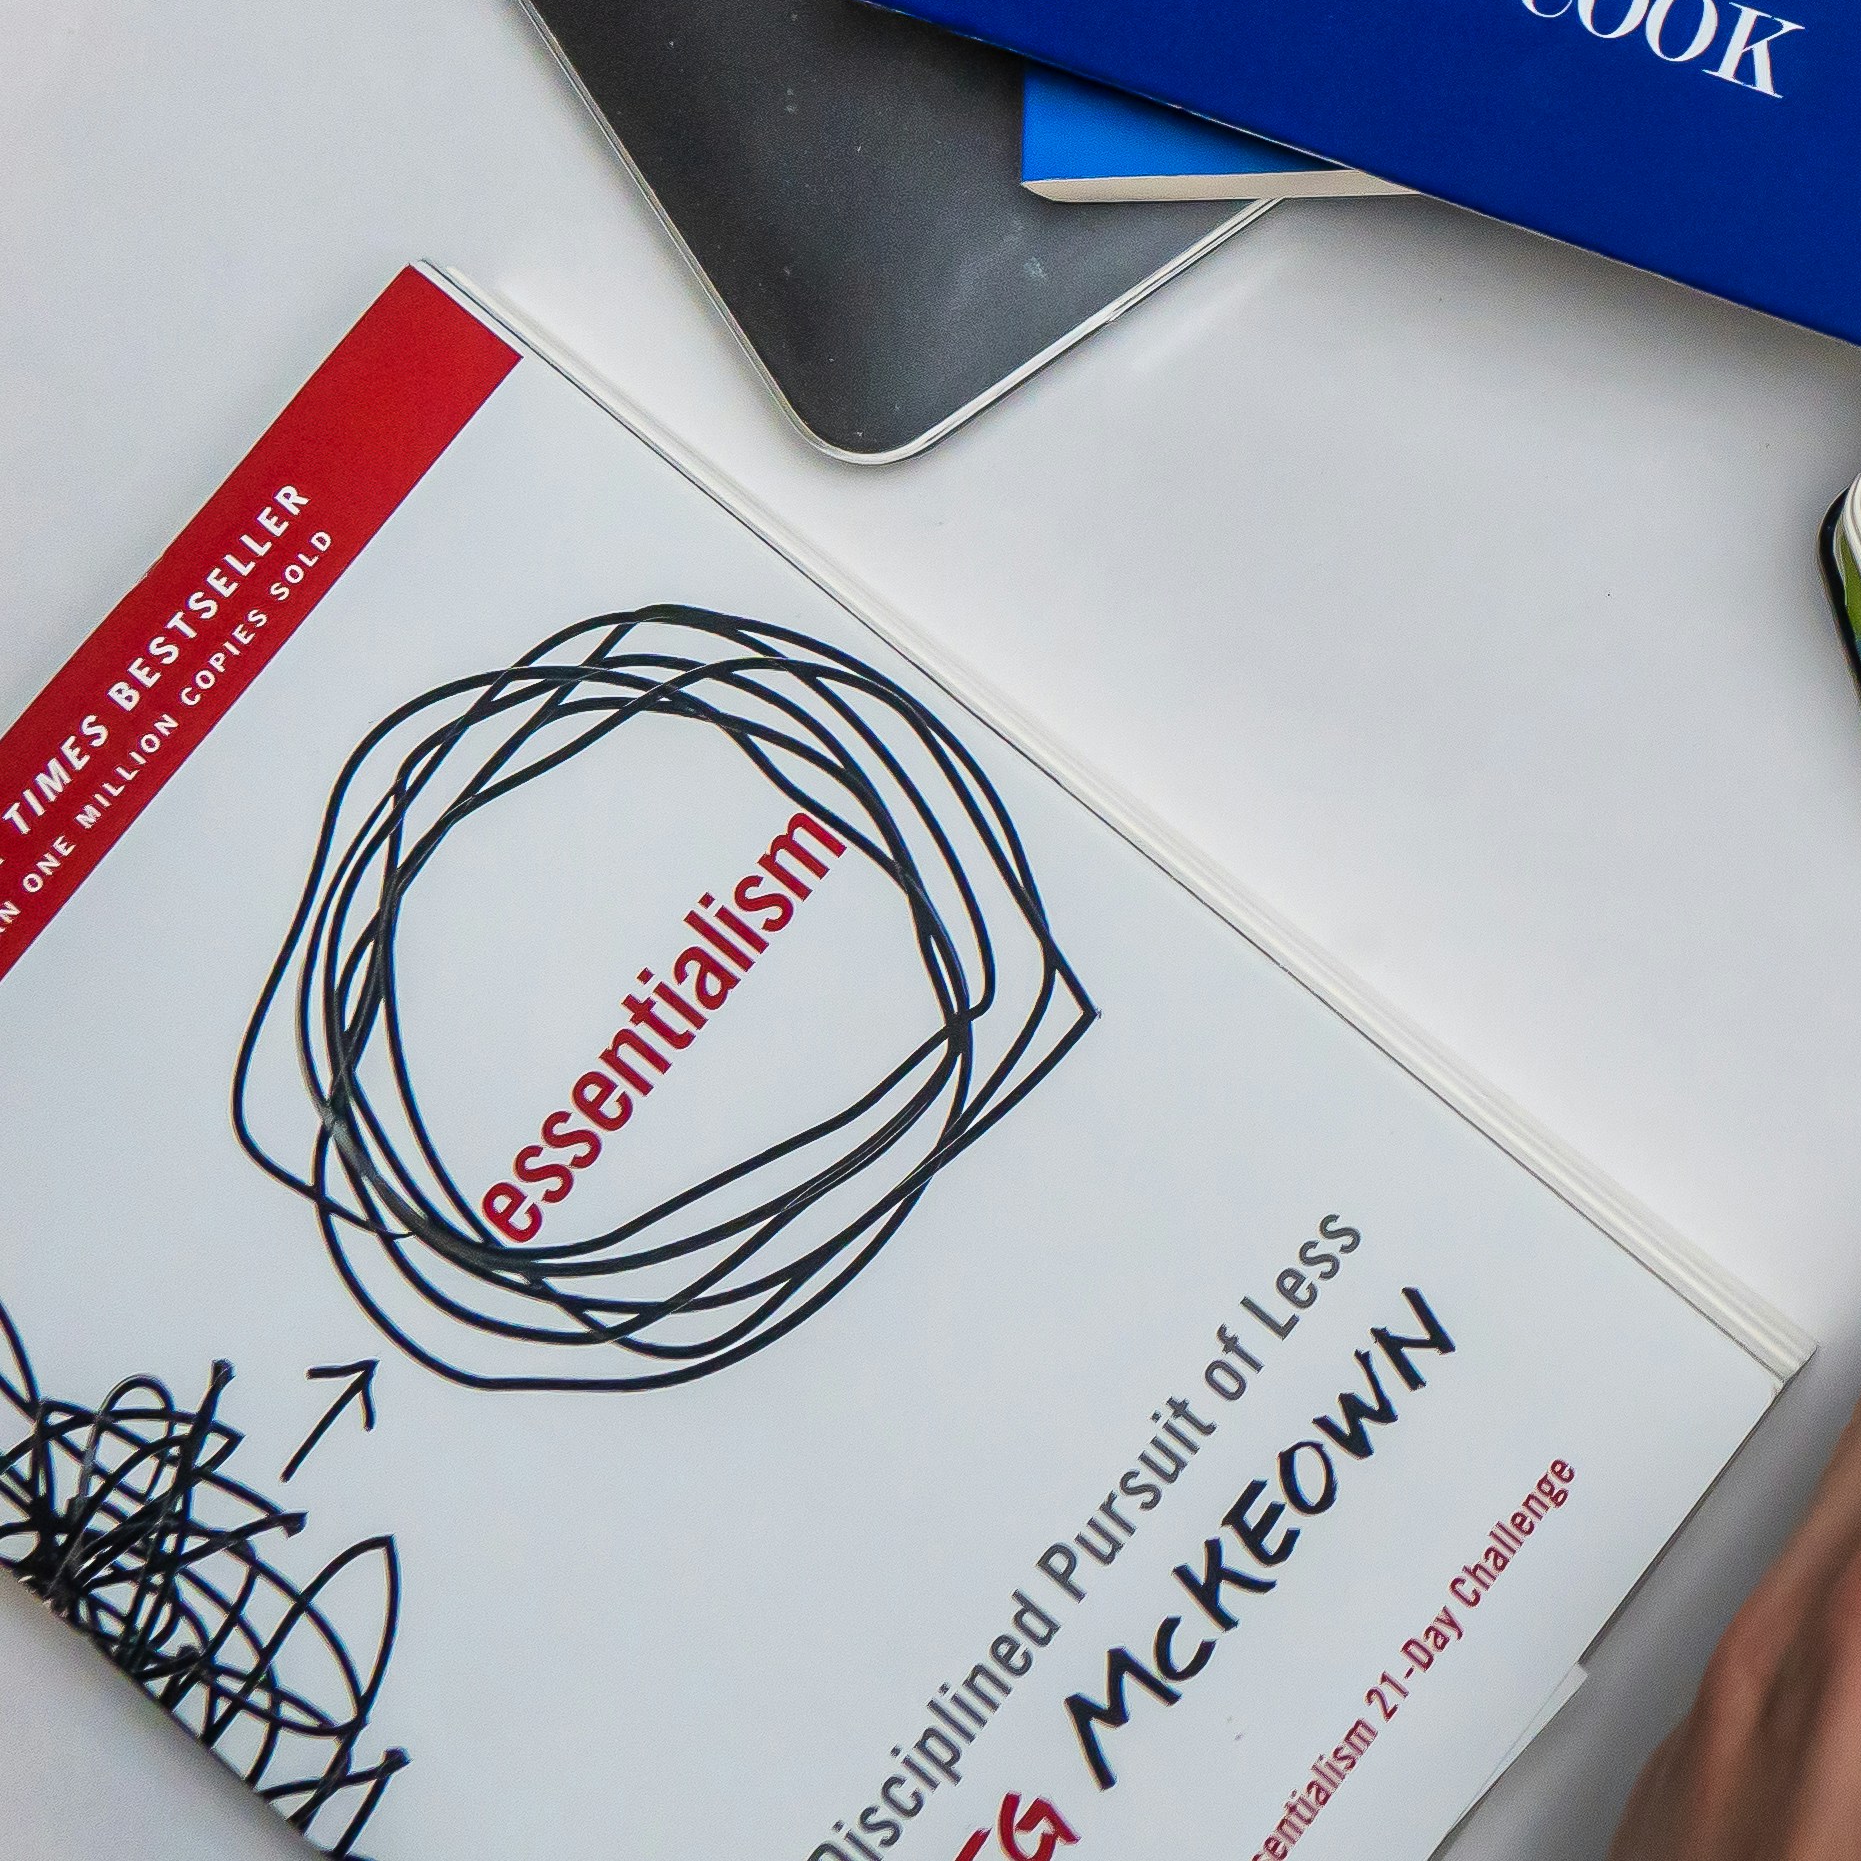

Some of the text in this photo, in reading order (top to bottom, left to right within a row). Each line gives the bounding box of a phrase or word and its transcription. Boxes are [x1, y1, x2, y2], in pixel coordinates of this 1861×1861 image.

[2, 484, 311, 836] TIMES BESTSELLER
[22, 529, 334, 895] ONE MILLION COPIES SOLD
[482, 811, 847, 1244] essentialism
[1035, 1395, 1218, 1604] Pursuit
[1203, 1324, 1265, 1403] of
[1240, 1212, 1363, 1341] Less
[1364, 1607, 1467, 1723] 21-Day
[1448, 1457, 1577, 1607] Challenge
